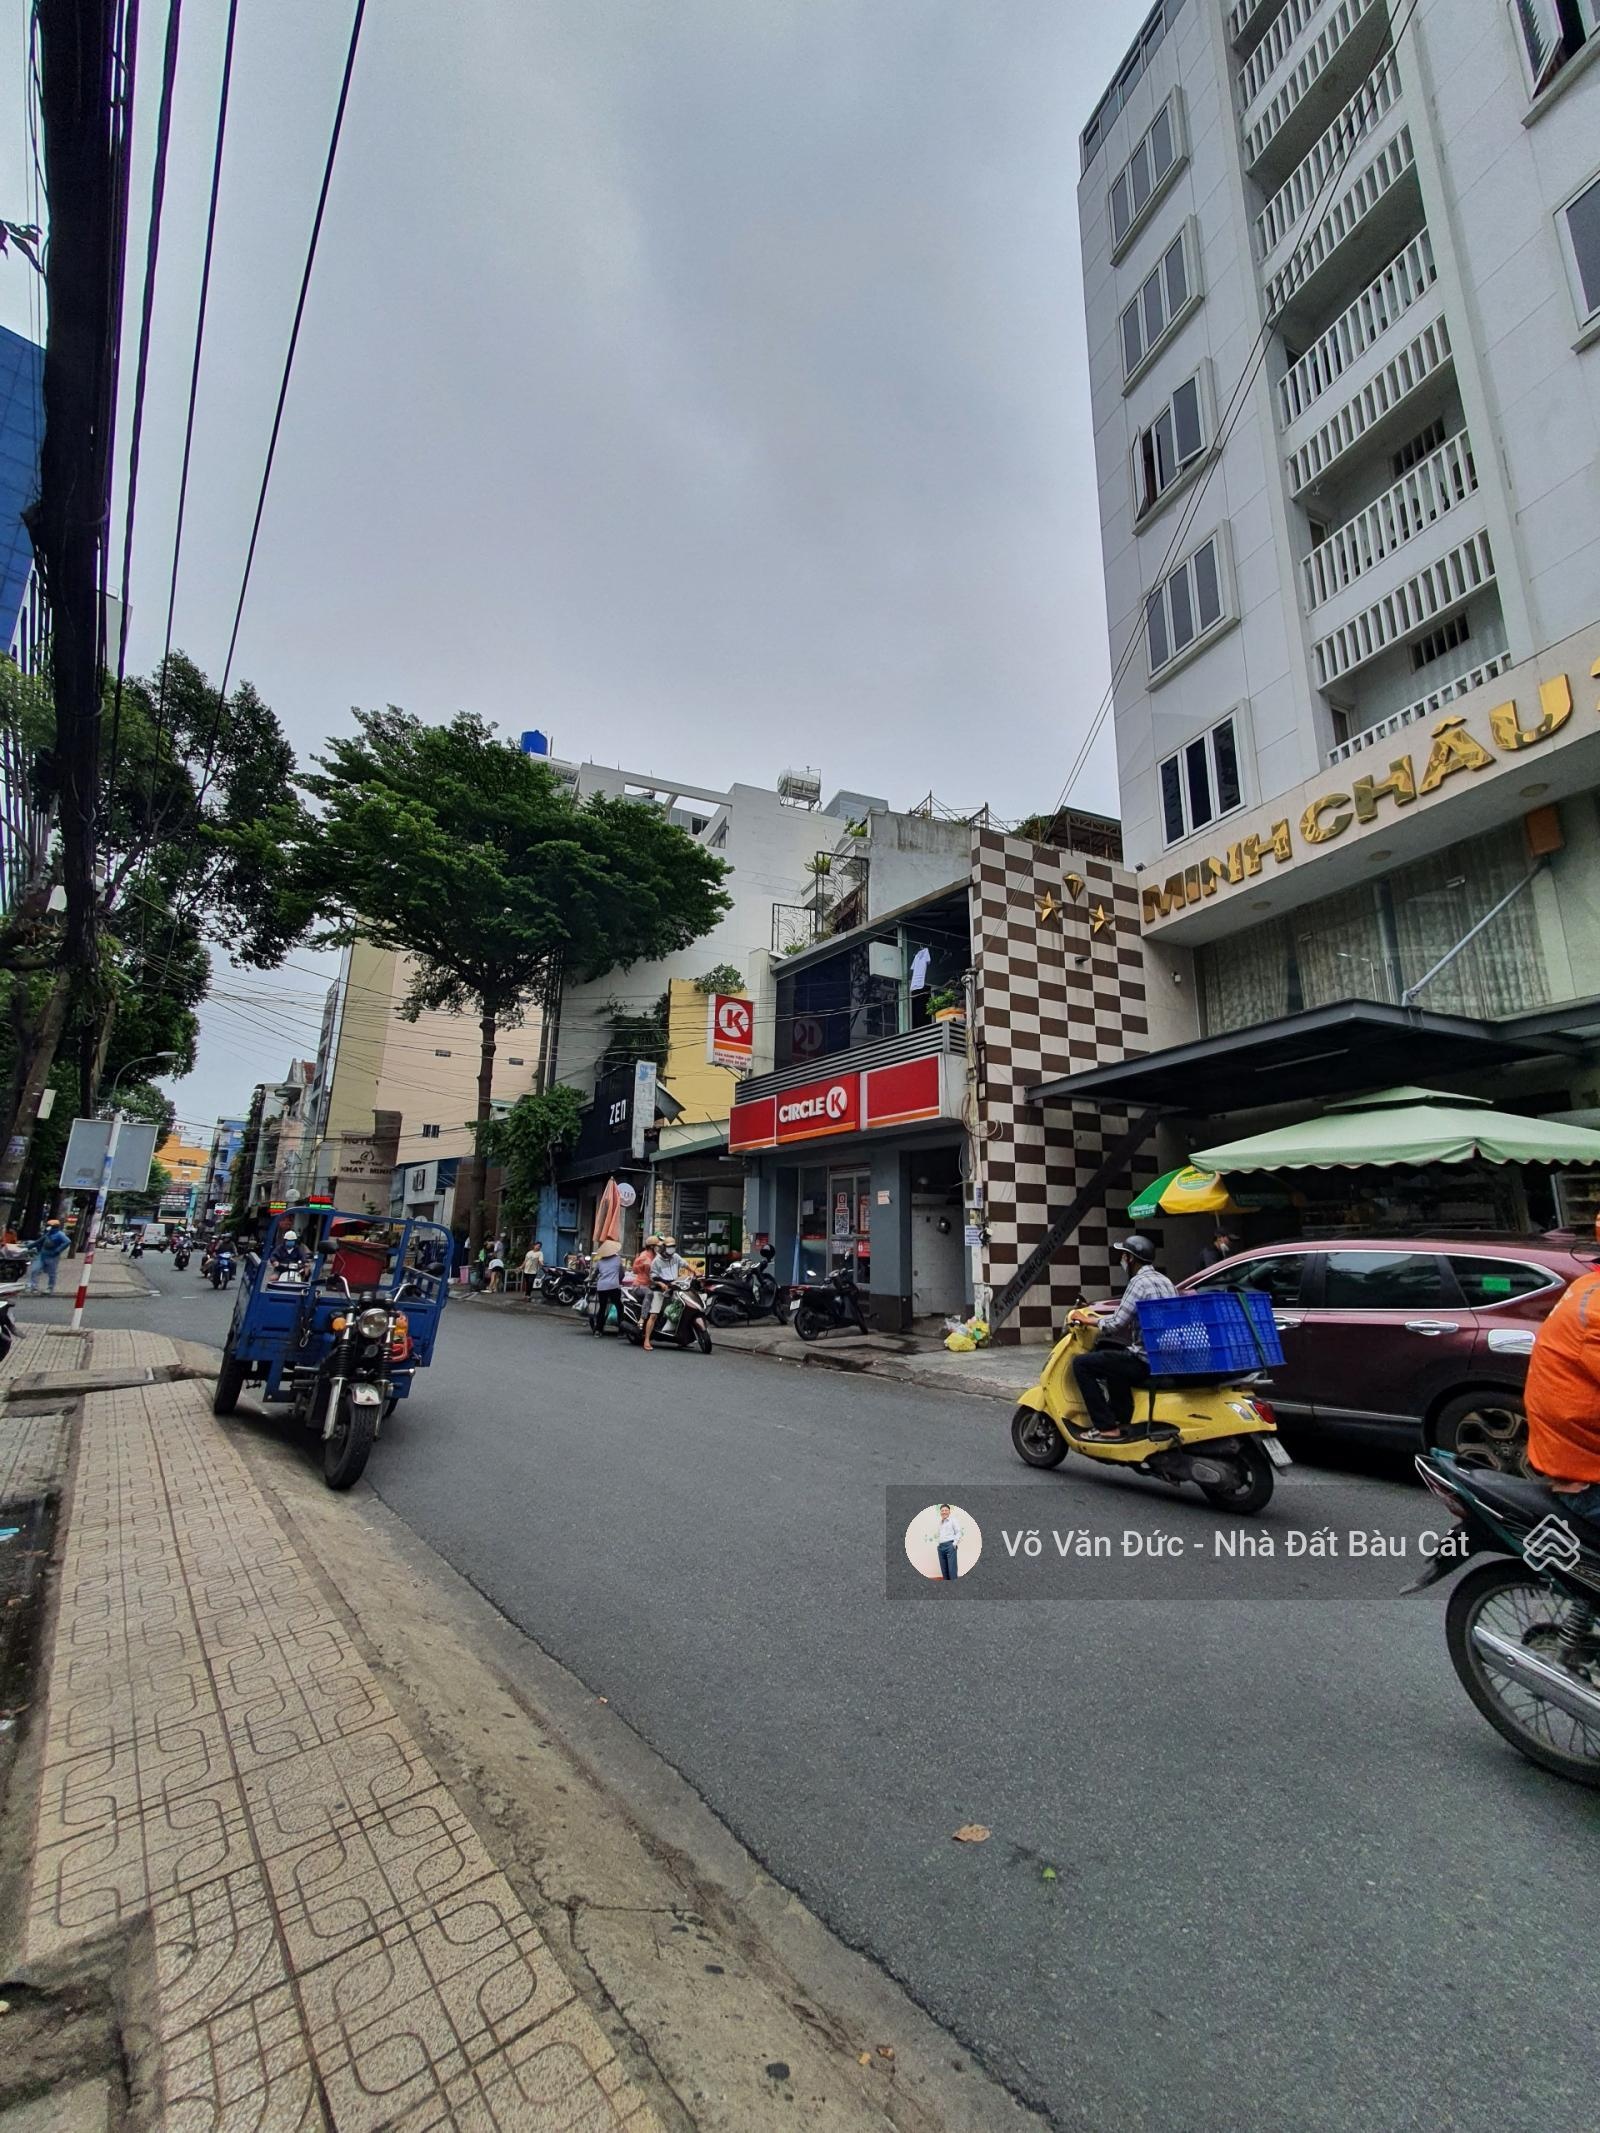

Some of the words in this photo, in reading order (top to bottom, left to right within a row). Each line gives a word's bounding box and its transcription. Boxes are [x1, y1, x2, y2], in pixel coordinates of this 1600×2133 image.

[1142, 818, 1293, 924] MINH
[1301, 674, 1573, 843] CHÂU
[779, 1097, 825, 1123] CIRCLE
[343, 1136, 379, 1146] HOTEL
